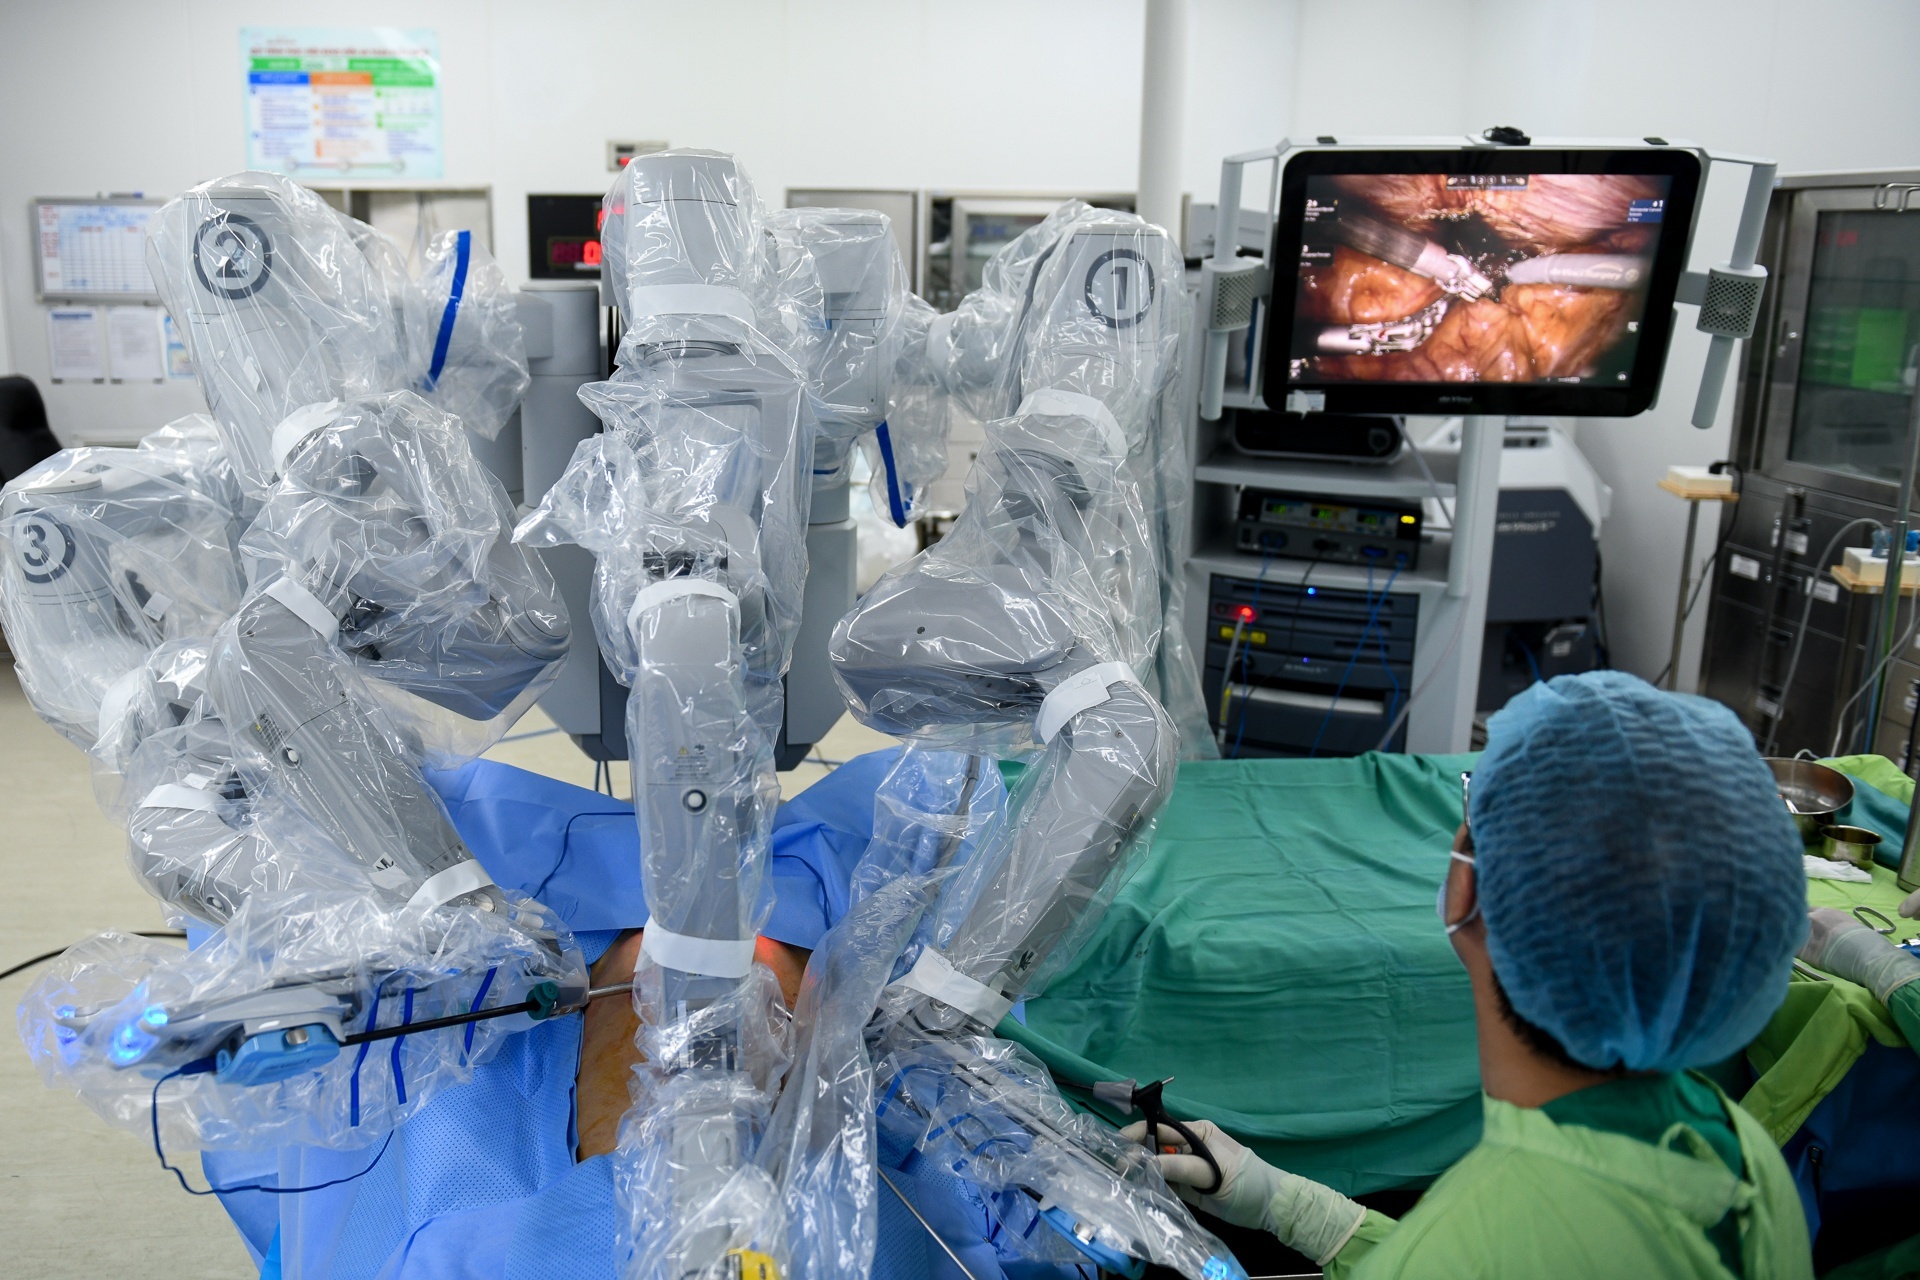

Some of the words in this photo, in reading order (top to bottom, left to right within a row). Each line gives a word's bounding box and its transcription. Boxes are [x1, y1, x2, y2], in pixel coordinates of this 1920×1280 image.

[215, 230, 249, 279] 2
[1110, 266, 1128, 310] 1
[23, 524, 50, 567] 3
